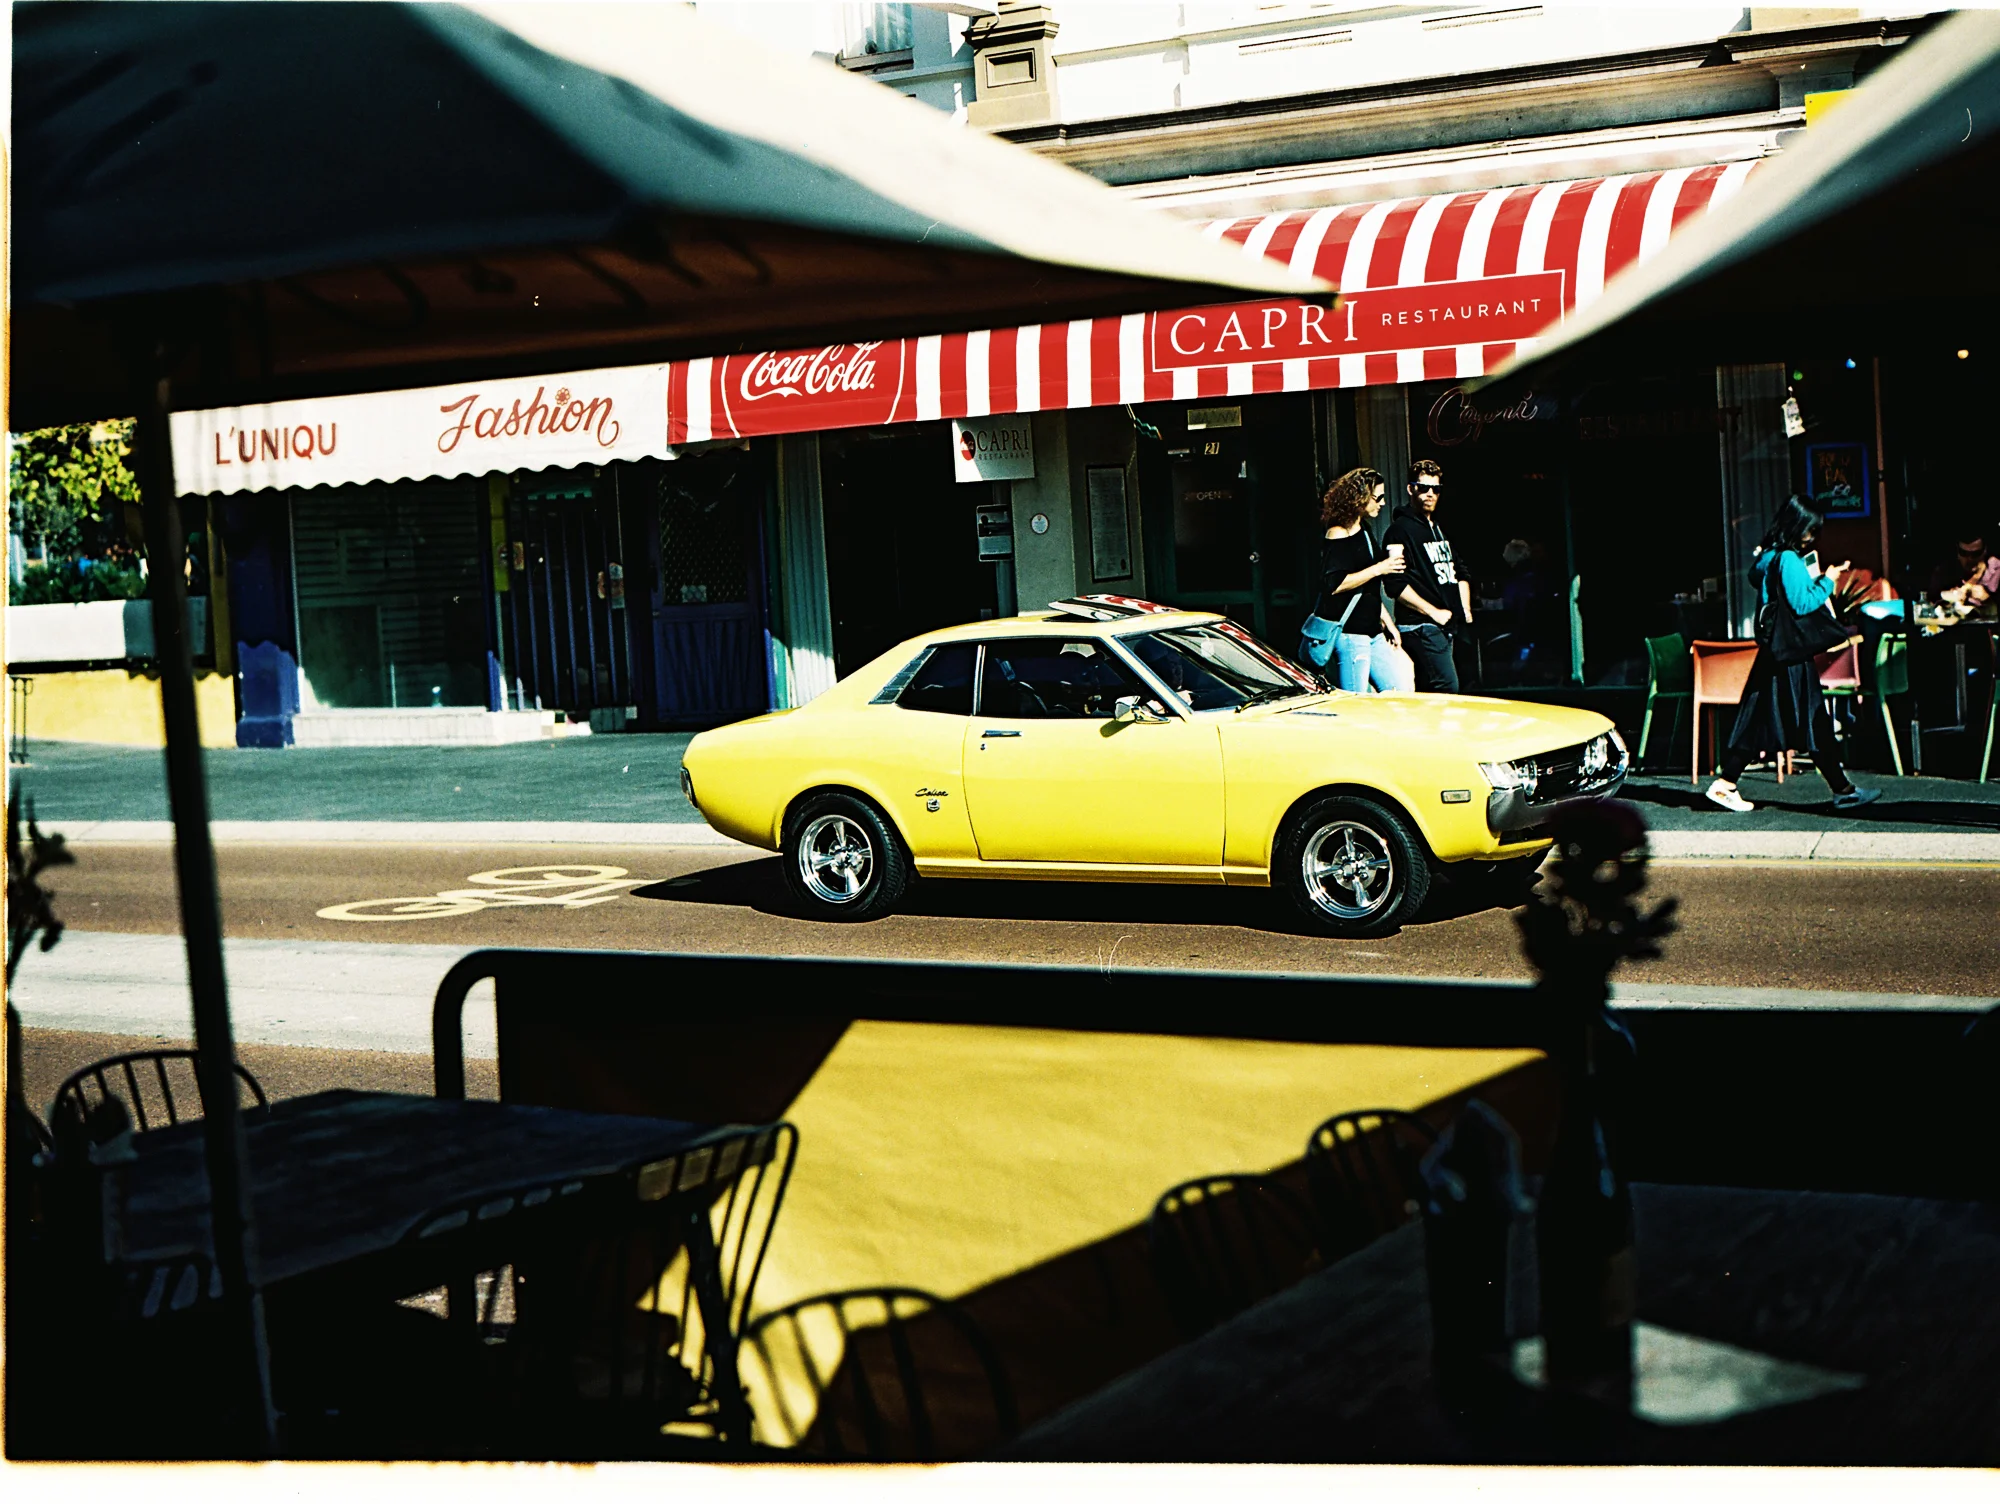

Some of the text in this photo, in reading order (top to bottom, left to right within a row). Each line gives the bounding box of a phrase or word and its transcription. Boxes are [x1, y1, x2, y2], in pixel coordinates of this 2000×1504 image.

[1169, 298, 1542, 355] CAPRI RESTAURANT
[214, 386, 623, 466] L'UNIQU Fashion
[1427, 385, 1539, 447] Capri
[976, 429, 1029, 452] CAPRI
[978, 452, 1029, 461] RESTAURANT
[1196, 490, 1221, 501] OPEN
